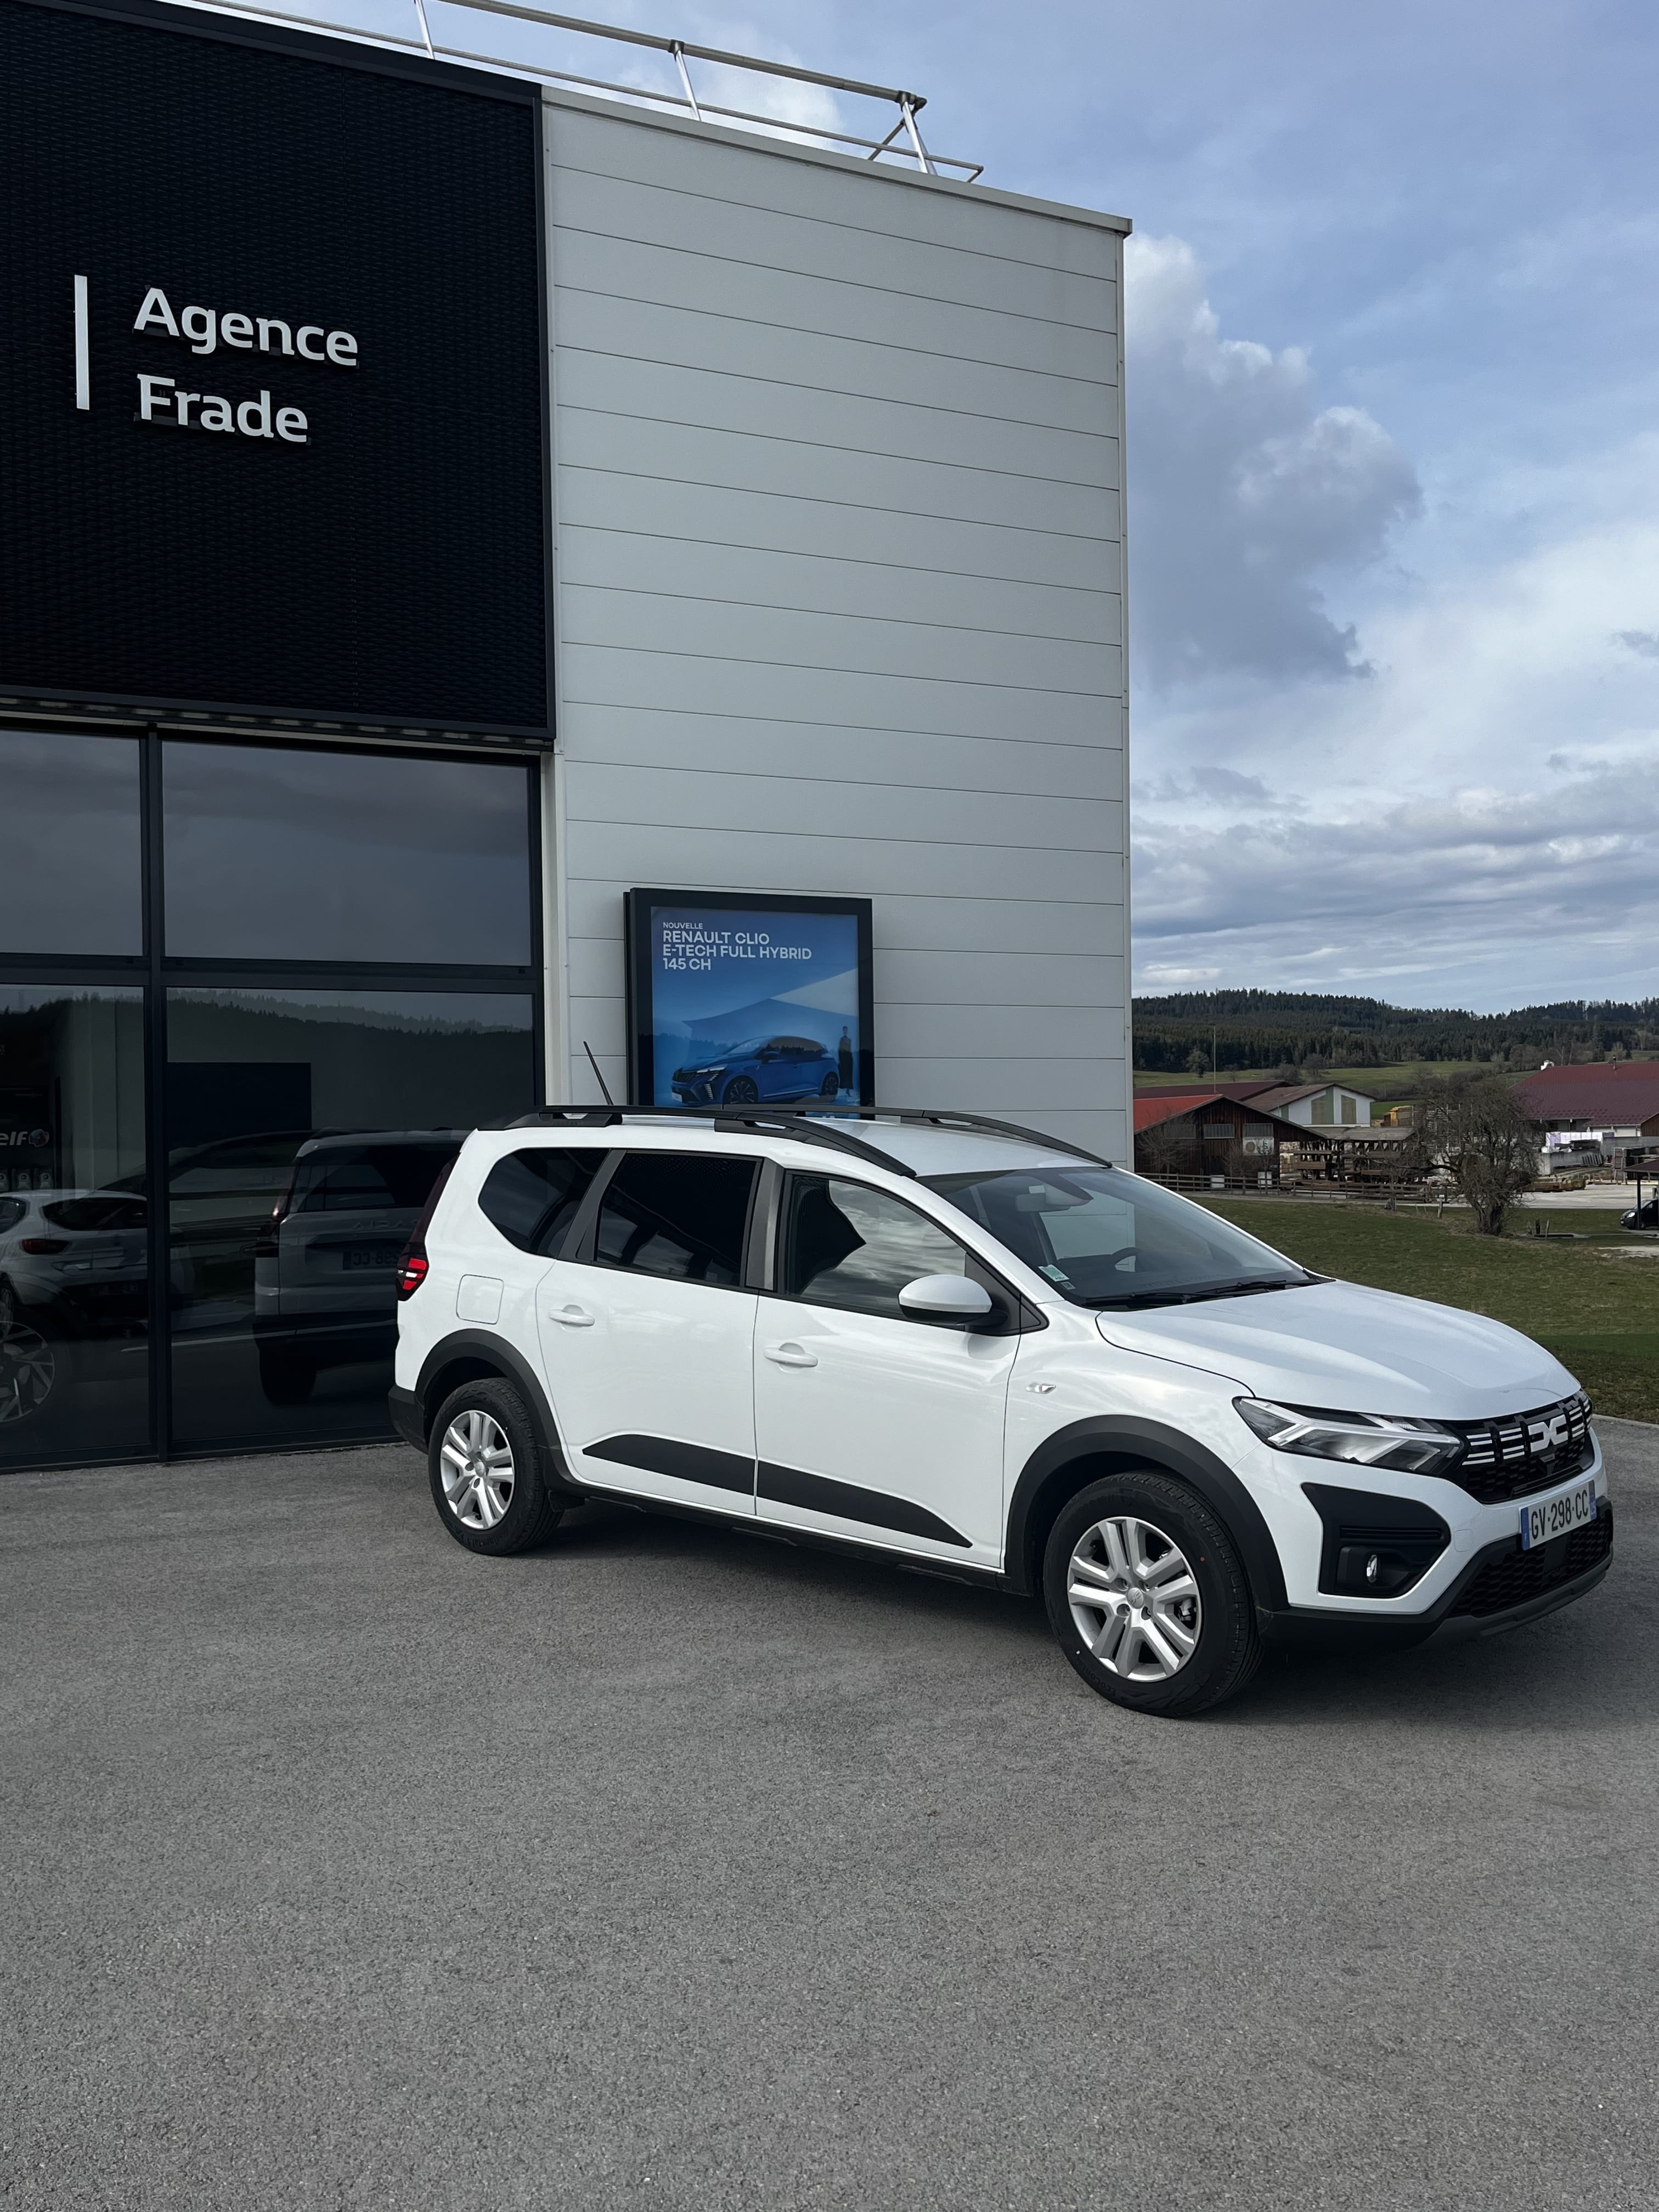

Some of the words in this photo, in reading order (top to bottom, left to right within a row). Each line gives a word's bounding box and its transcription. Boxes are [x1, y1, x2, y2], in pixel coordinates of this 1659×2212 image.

[133, 287, 359, 366] Agence
[137, 373, 308, 443] Frade
[663, 930, 731, 944] RENAULT
[735, 932, 770, 945] CLIO
[663, 944, 716, 957] E-TECH
[720, 945, 756, 958] FULL
[759, 946, 812, 960] HYBRID
[663, 957, 686, 970] 145
[689, 958, 712, 970] CH
[0, 1131, 28, 1146] elf
[1531, 1489, 1589, 1540] GV-298-CC
